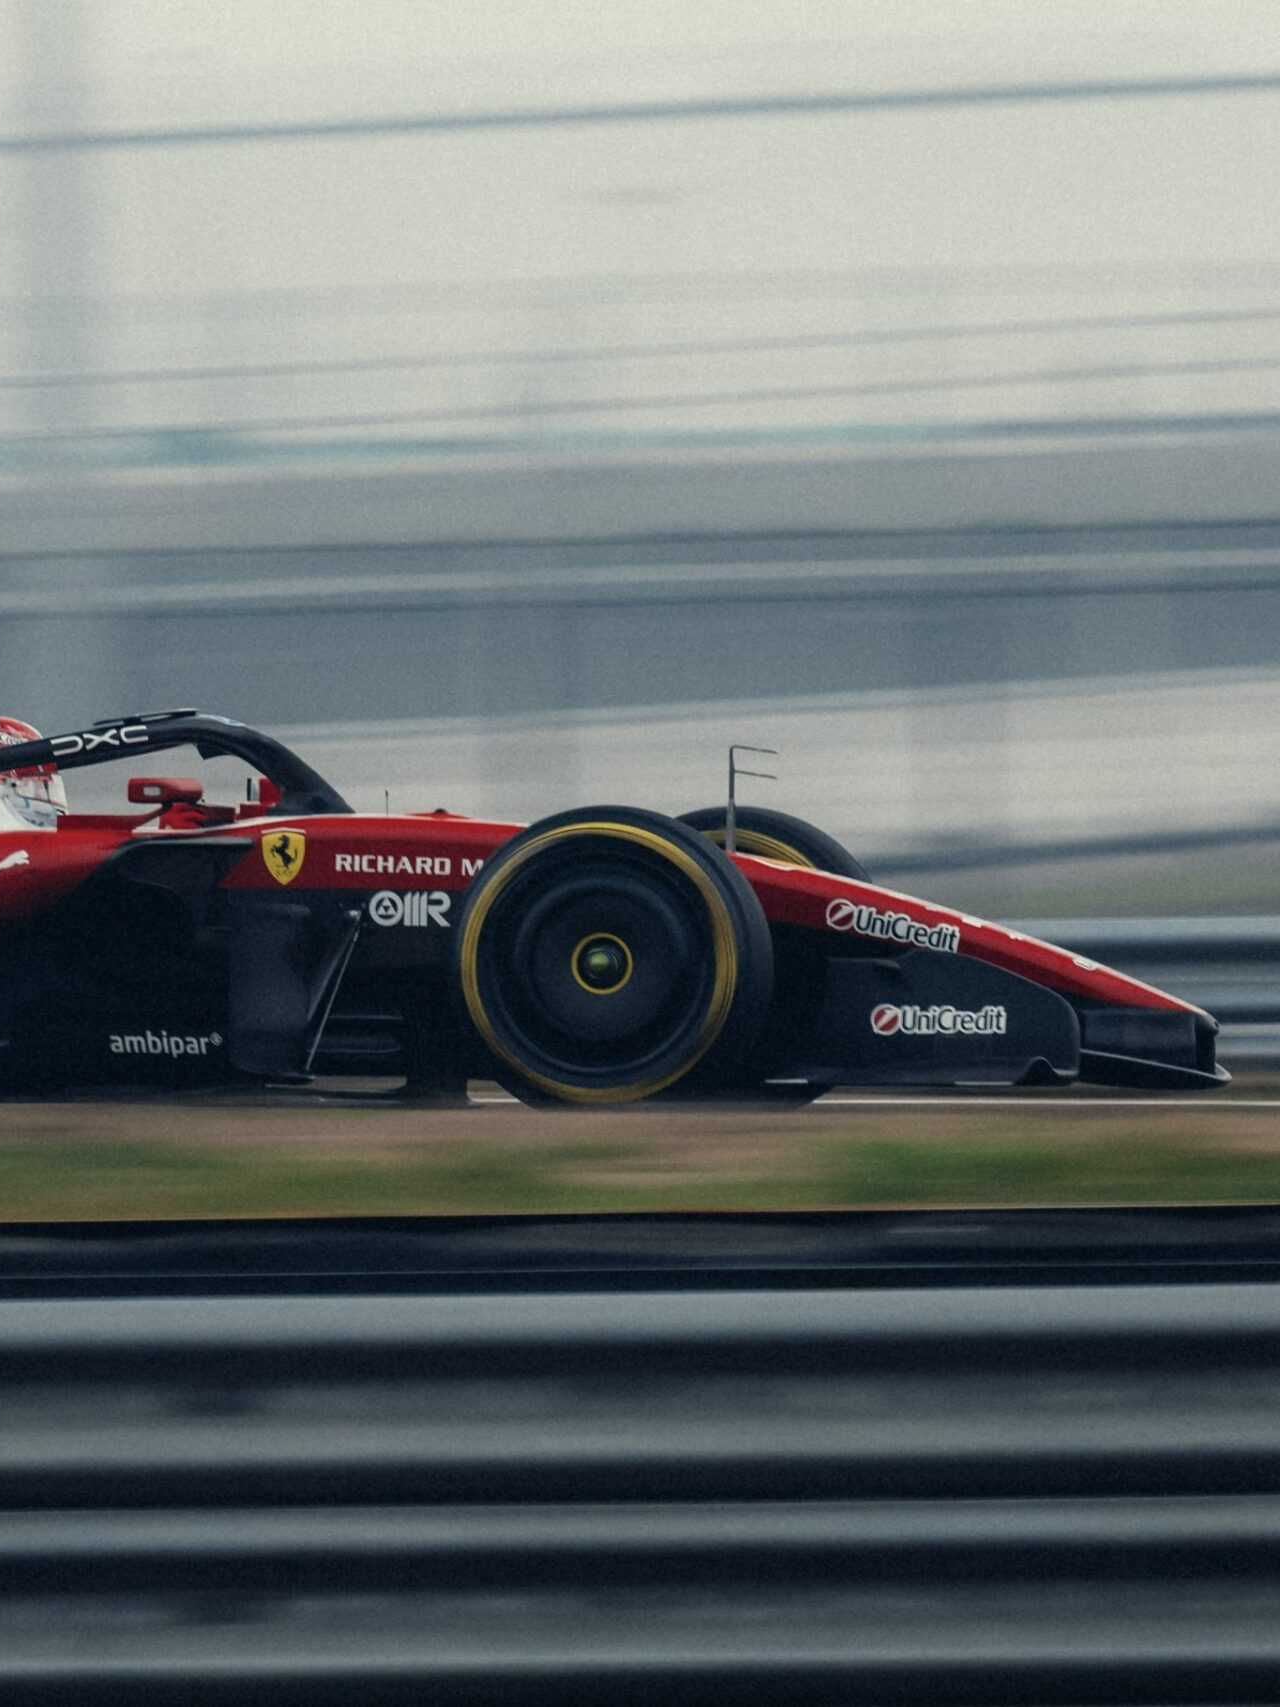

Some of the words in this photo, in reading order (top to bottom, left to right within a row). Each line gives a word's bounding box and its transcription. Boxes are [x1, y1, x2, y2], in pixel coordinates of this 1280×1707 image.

[50, 725, 149, 756] DXC
[335, 853, 451, 876] RICHARD
[855, 907, 958, 951] UniCredit
[901, 1006, 1005, 1033] UniCredit
